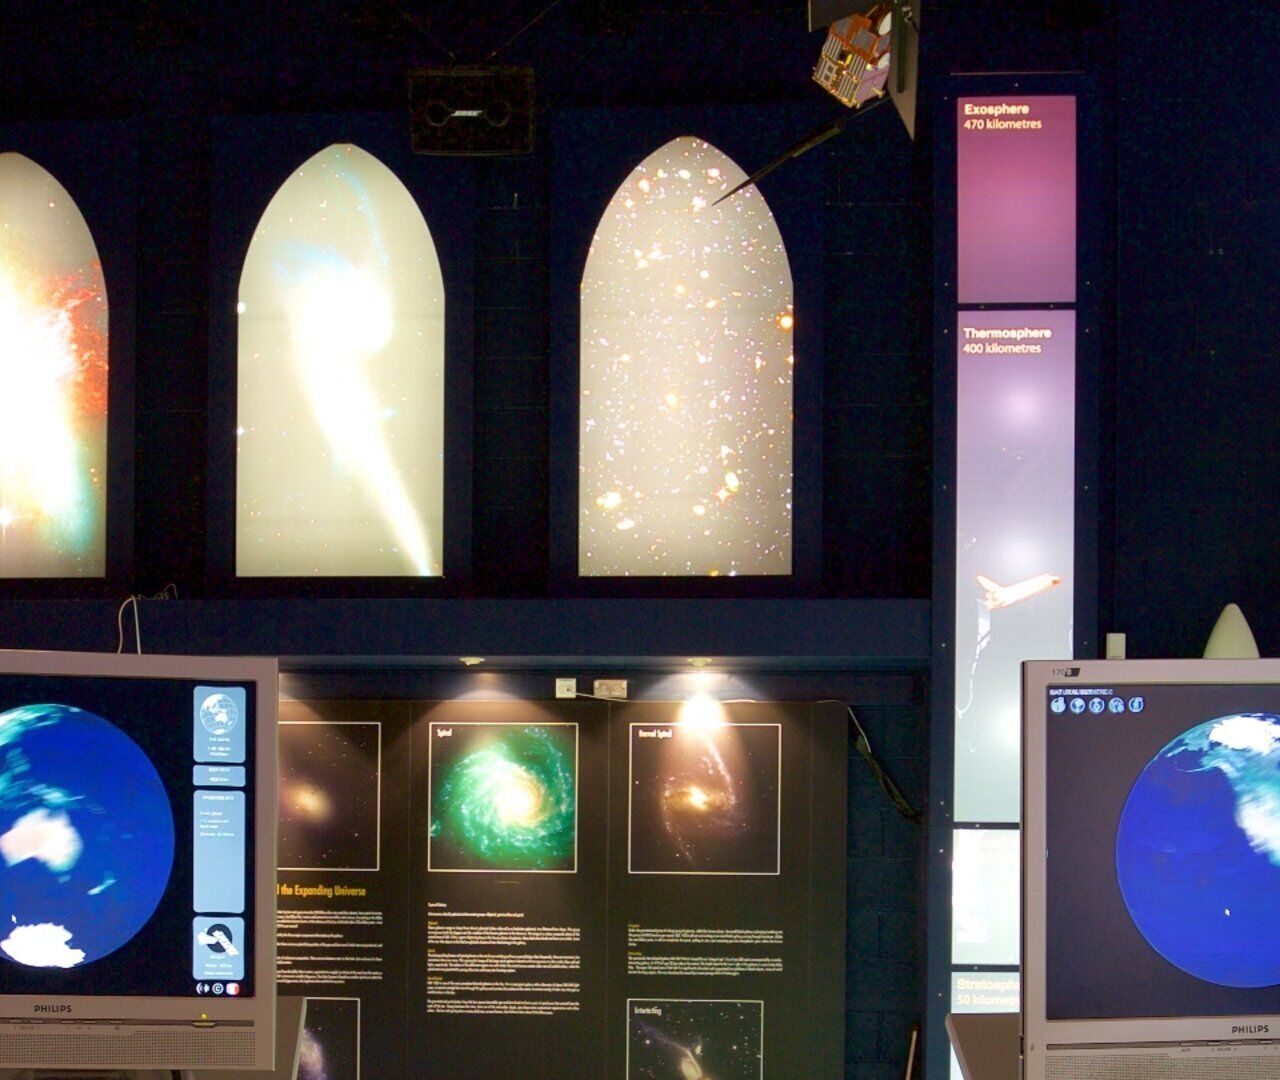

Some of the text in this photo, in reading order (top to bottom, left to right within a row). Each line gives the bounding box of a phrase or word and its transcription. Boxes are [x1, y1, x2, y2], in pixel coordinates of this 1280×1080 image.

[964, 103, 1030, 117] Exosphere
[964, 119, 1042, 129] 470 kilometres
[963, 327, 1052, 341] Thermosphere
[963, 342, 1042, 354] 400 kilometres
[294, 884, 333, 898] Expanding
[33, 1004, 72, 1013] PHILIPS
[1231, 1024, 1270, 1034] PHILIPS
